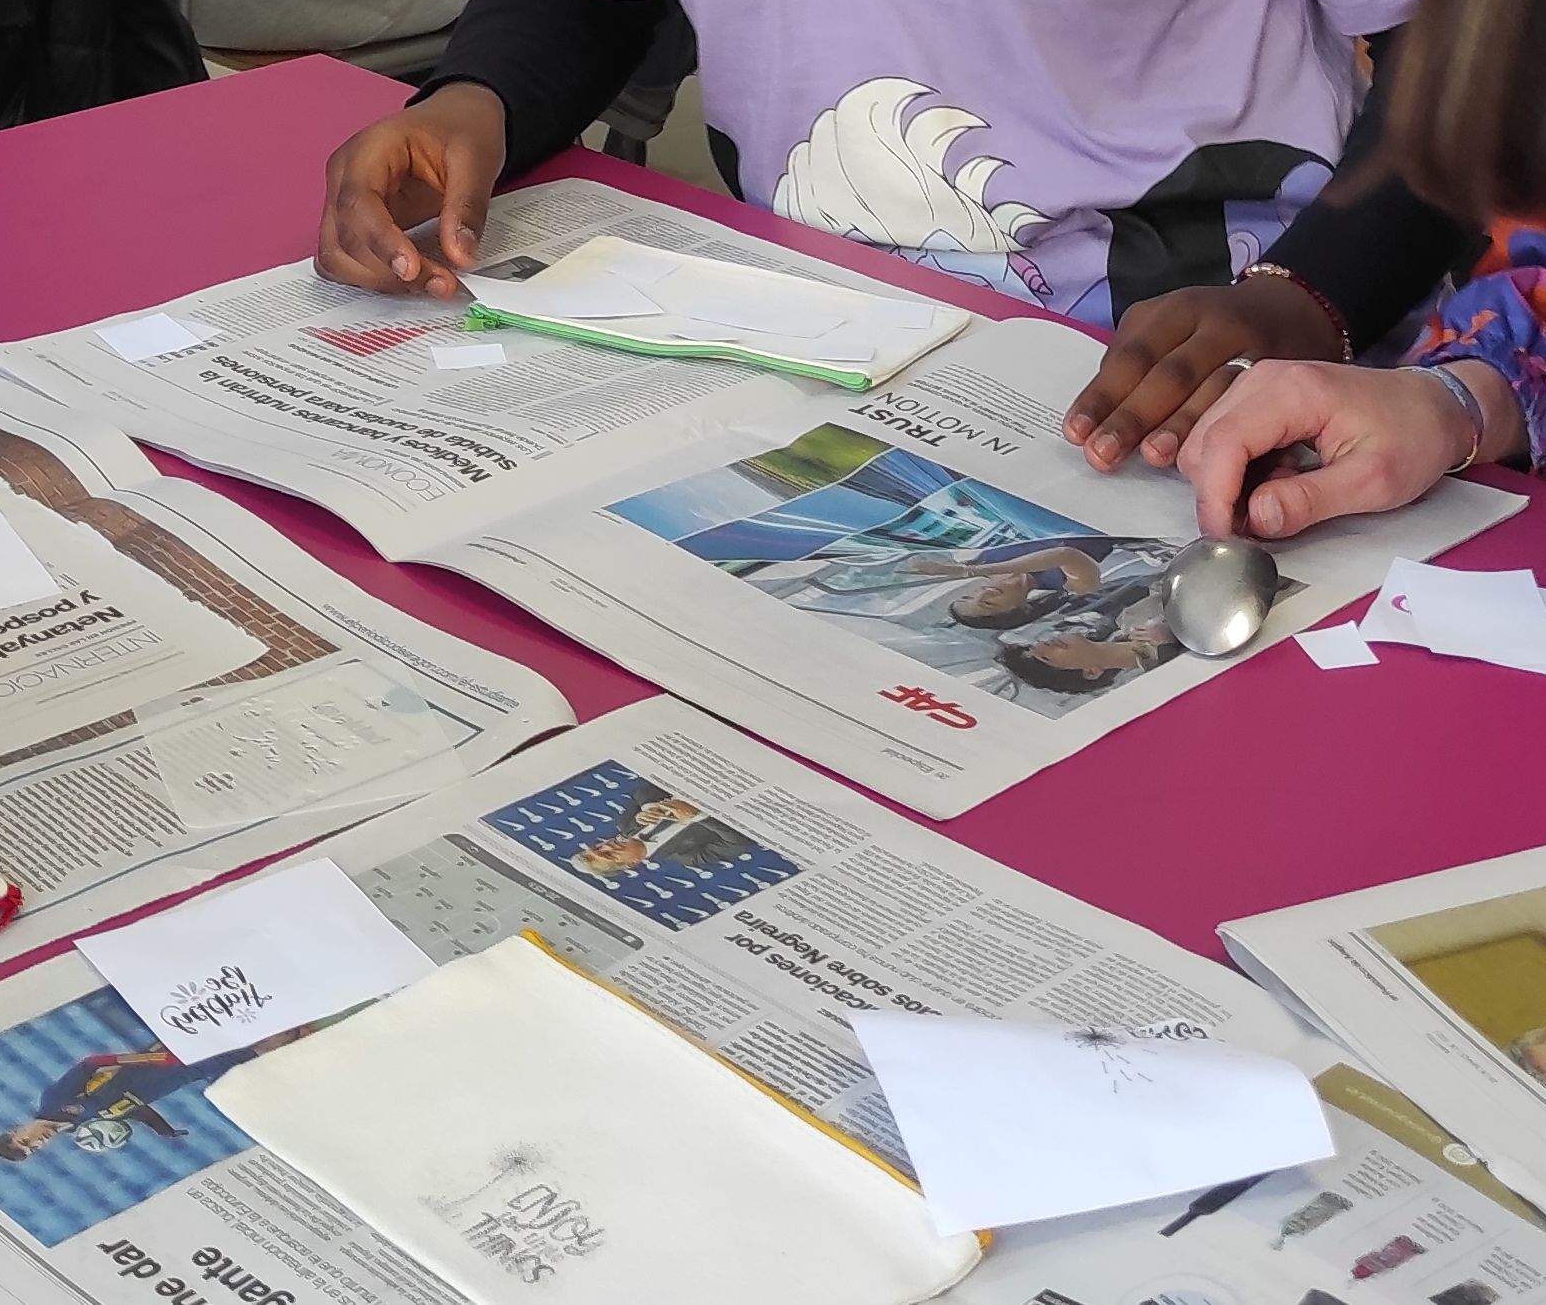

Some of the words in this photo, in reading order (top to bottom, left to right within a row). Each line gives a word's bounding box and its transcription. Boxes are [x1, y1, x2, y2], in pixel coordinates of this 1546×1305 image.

[198, 369, 223, 383] la
[211, 355, 313, 399] pensiones
[217, 378, 295, 412] nutrirán
[304, 395, 359, 414] para
[292, 408, 391, 440] bancarios
[348, 410, 418, 432] cuotas
[416, 427, 447, 439] de
[848, 404, 948, 447] TRUST
[873, 392, 985, 440] MOTION
[383, 435, 410, 444] y
[444, 435, 517, 471] subida
[981, 436, 1021, 456] IN
[400, 439, 493, 483] Médicos
[78, 589, 103, 605] y
[876, 685, 977, 729] CAF
[724, 933, 774, 956] por
[733, 910, 828, 965] Negreira
[827, 961, 893, 996] sobre
[96, 1239, 162, 1279] dar
